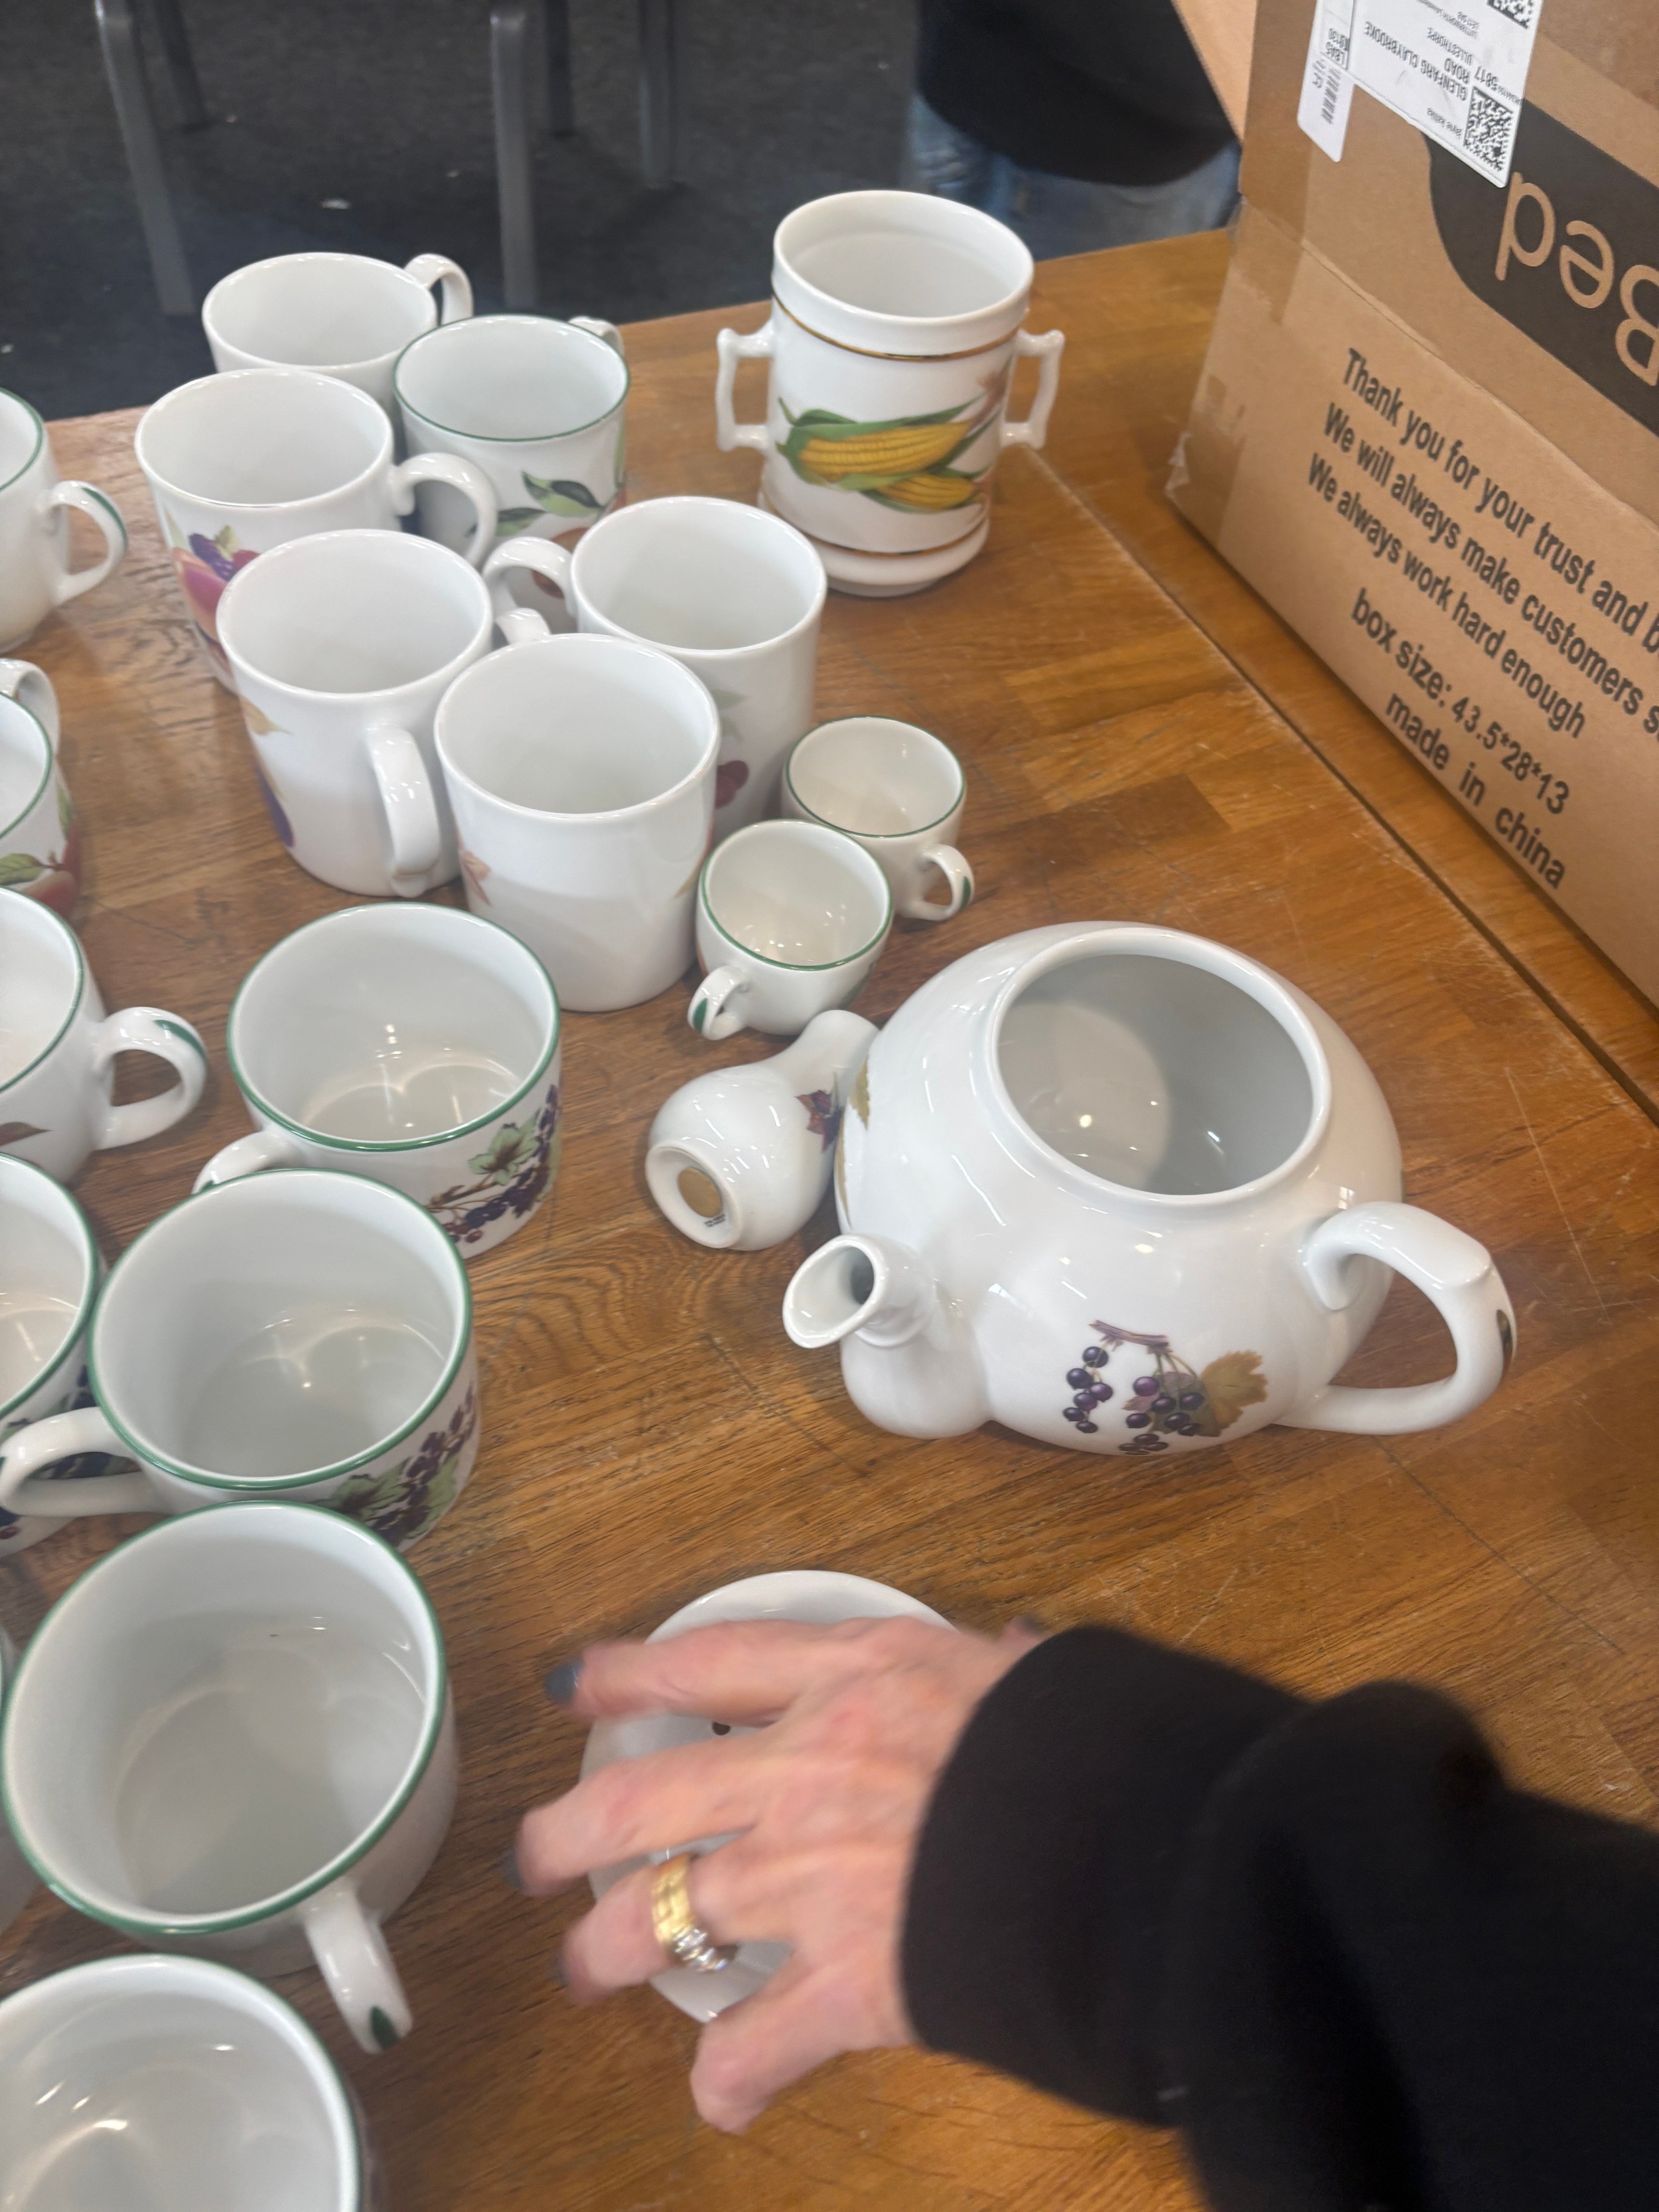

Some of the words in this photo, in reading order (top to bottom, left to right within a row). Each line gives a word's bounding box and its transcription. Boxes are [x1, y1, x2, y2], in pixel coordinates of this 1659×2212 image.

[1364, 21, 1419, 68] CLAYBROOKE
[1419, 58, 1468, 102] GLENFARG
[1444, 58, 1471, 85] ROAD
[1494, 171, 1659, 386] Bed
[1324, 402, 1354, 453] We
[1357, 439, 1394, 488] will
[1392, 473, 1461, 550] always
[1460, 536, 1520, 605] make
[1521, 594, 1644, 716] customers
[1342, 347, 1404, 427] Thank
[1399, 409, 1447, 462] you
[1444, 439, 1480, 490] for
[1474, 477, 1536, 538] your
[1533, 522, 1597, 595] trust
[1591, 579, 1649, 637] and
[1307, 453, 1338, 503] We
[1336, 491, 1403, 565] always
[1402, 550, 1454, 612] work
[1451, 591, 1507, 660] hard
[1500, 648, 1586, 739] enough
[1350, 587, 1398, 654] box
[1394, 643, 1453, 708] size:
[1386, 692, 1451, 771] made
[1459, 761, 1486, 808] in
[1494, 806, 1567, 890] china
